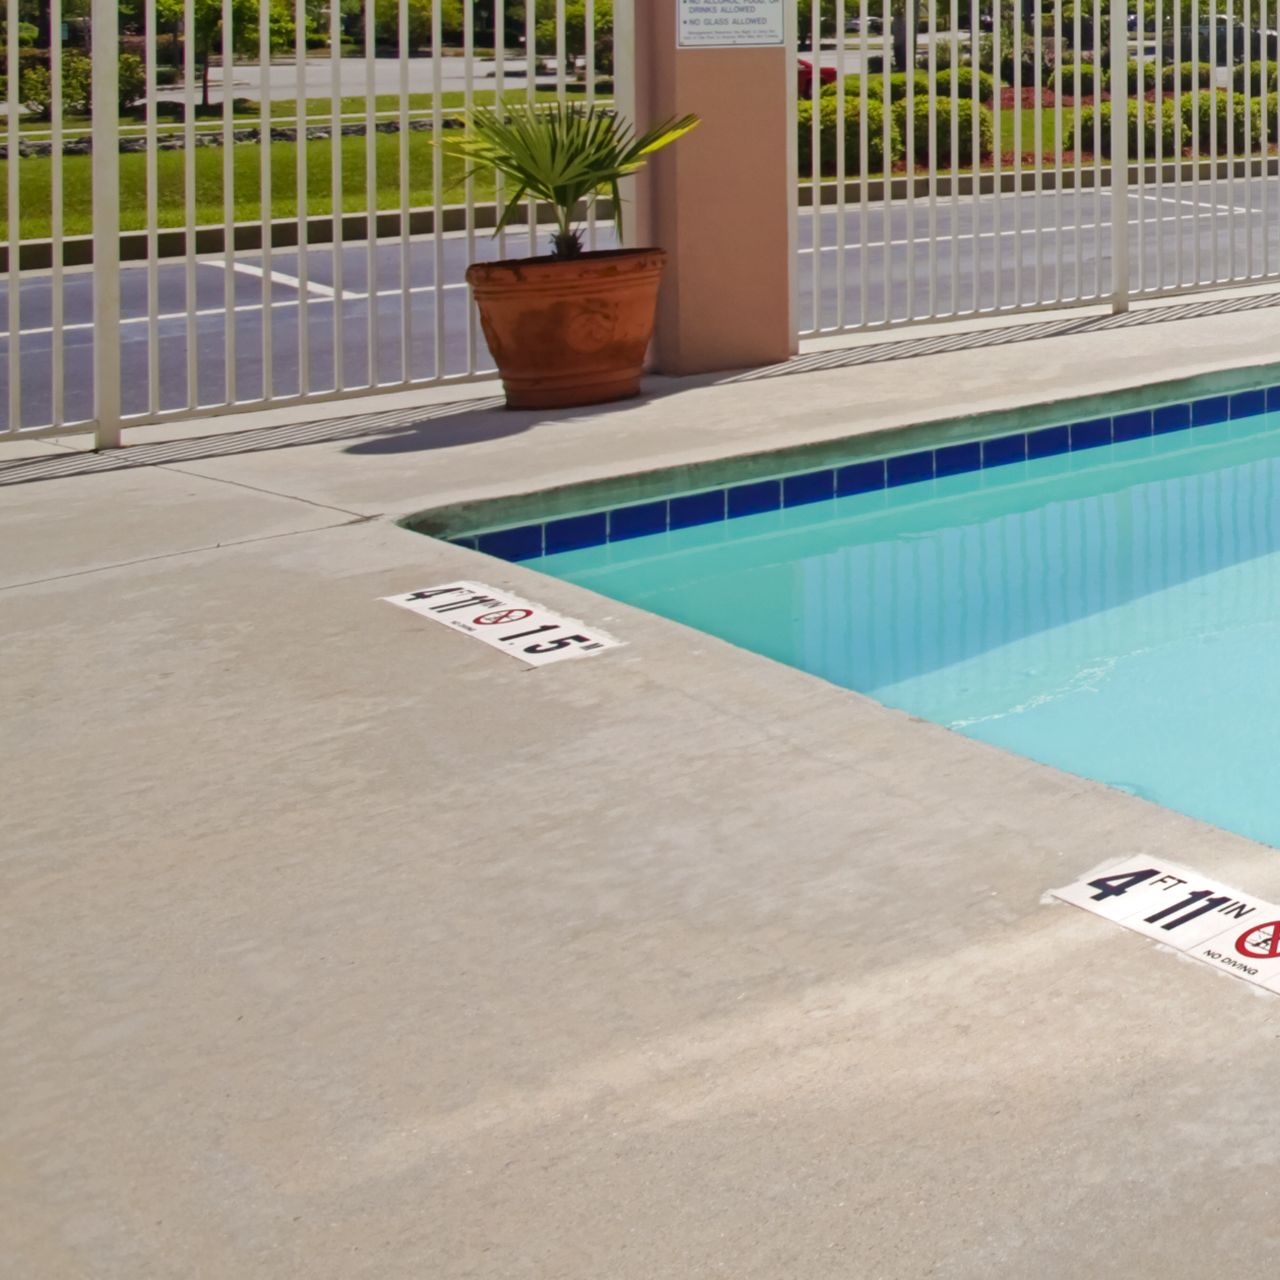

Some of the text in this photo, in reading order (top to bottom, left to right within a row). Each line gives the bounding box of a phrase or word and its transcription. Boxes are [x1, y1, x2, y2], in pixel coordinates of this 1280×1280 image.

[703, 18, 729, 26] GLASS
[732, 17, 767, 25] ALLOWED
[1203, 949, 1259, 976] NO DIVING
